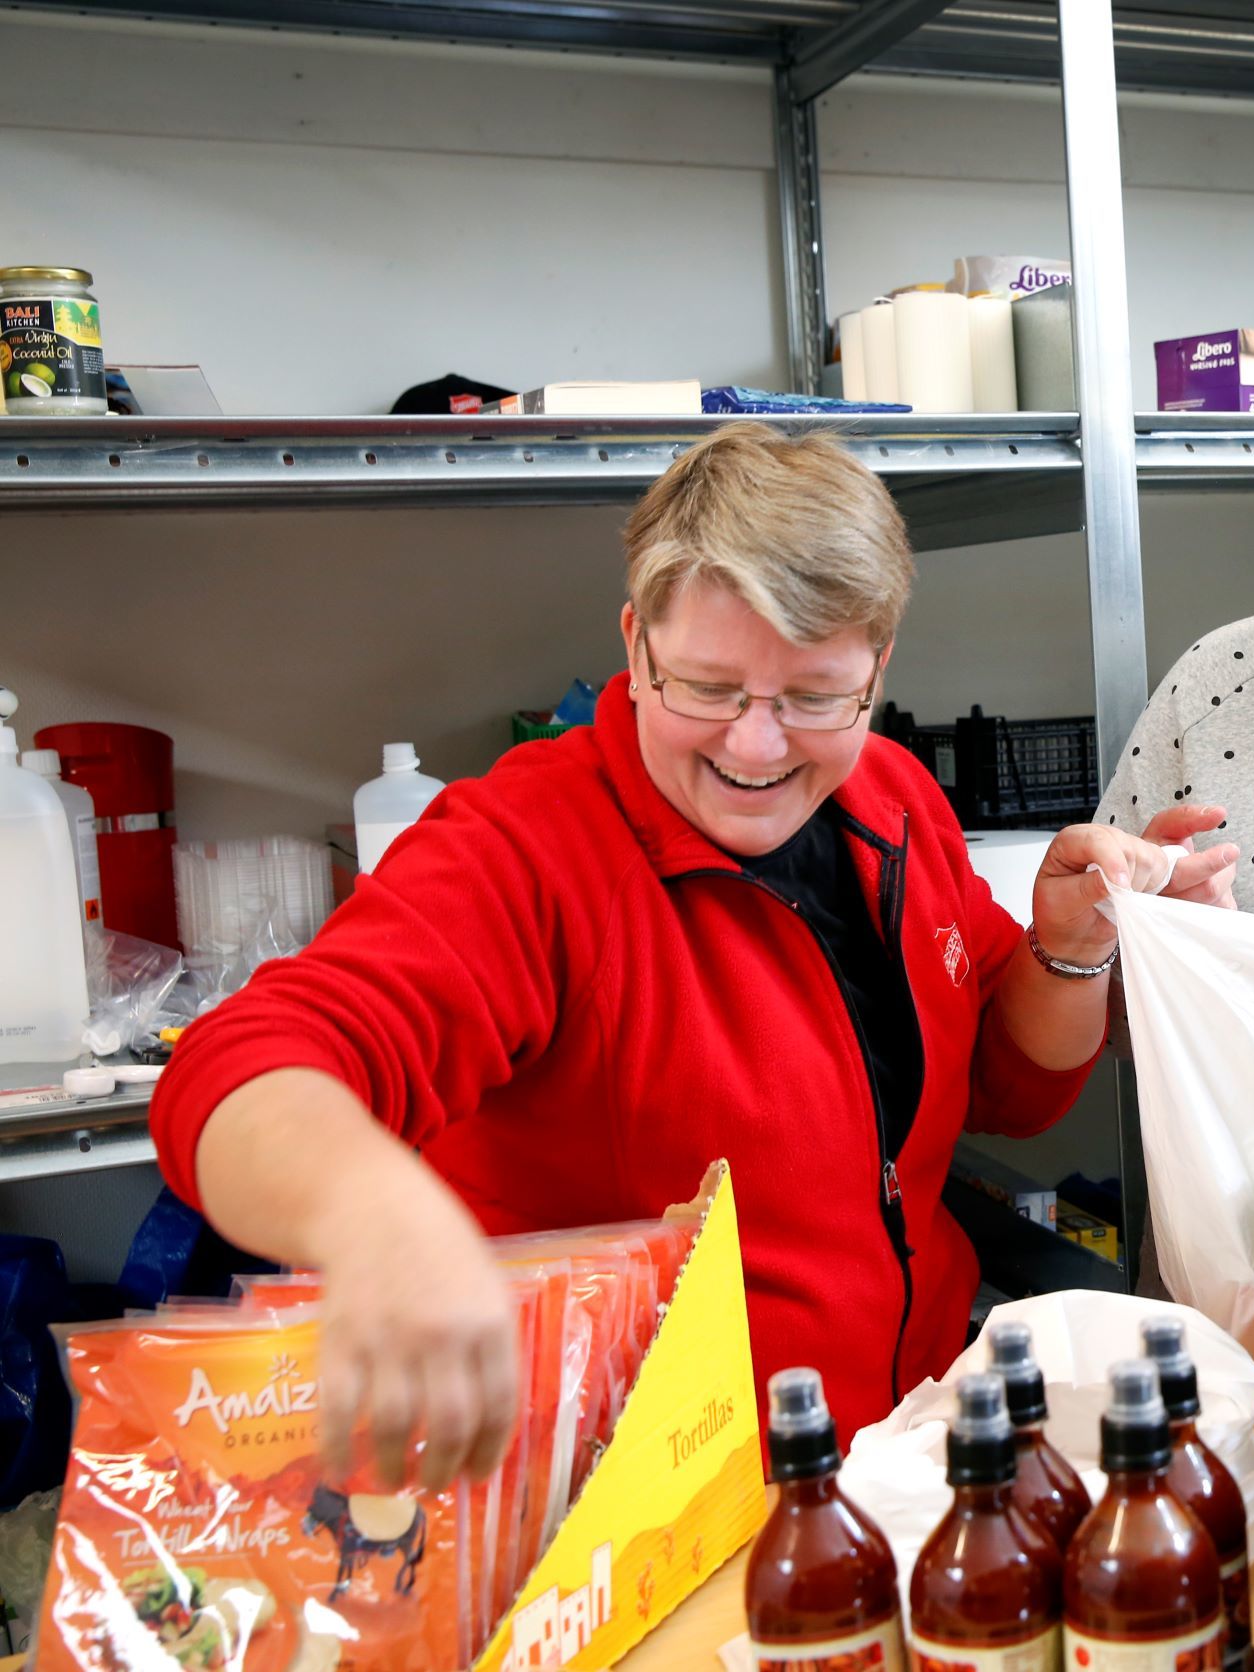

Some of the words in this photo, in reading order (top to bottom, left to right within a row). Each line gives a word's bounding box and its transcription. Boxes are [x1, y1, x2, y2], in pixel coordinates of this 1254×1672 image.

[1009, 265, 1070, 291] Liber
[5, 306, 40, 319] BALI
[6, 319, 40, 327] KITCHEN
[25, 330, 57, 348] Virgin
[13, 345, 55, 359] Coconut
[56, 346, 72, 359] Oil
[1192, 341, 1232, 361] Libero
[172, 1367, 321, 1433] Amaiz
[667, 1397, 734, 1470] Tortillas
[157, 1496, 212, 1518] Wheat
[213, 1513, 291, 1558] Wraps
